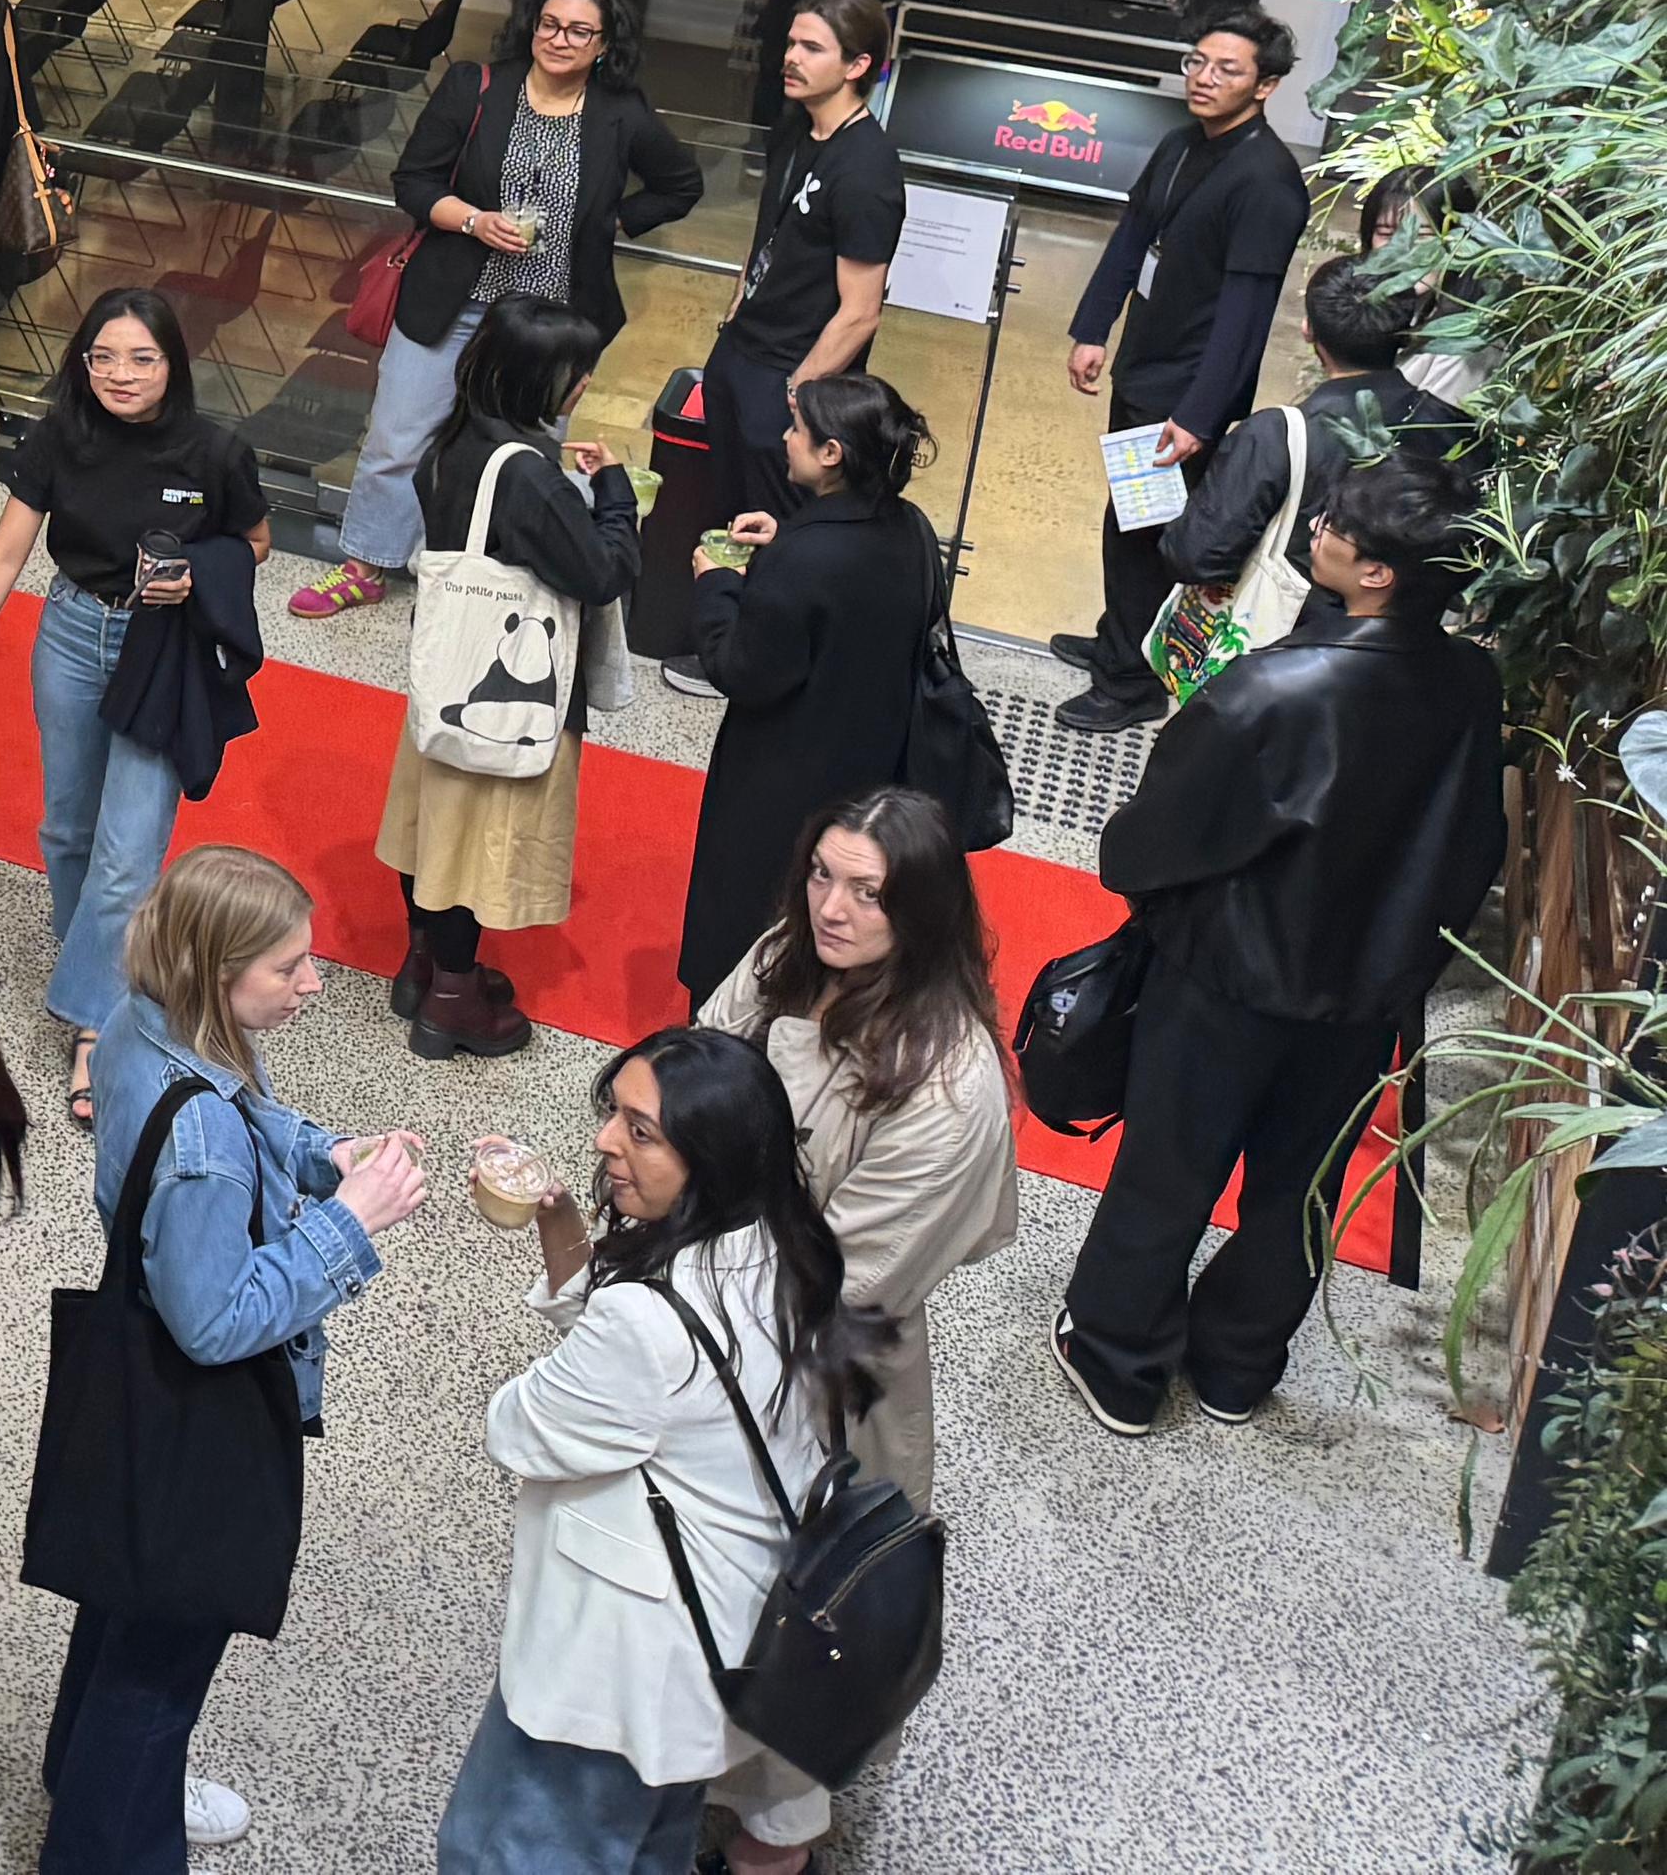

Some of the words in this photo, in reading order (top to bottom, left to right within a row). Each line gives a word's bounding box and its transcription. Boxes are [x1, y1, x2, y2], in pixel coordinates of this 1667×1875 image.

[994, 125, 1049, 154] Red
[1050, 135, 1104, 164] Bull
[445, 581, 463, 593] Une
[465, 585, 493, 598] petite
